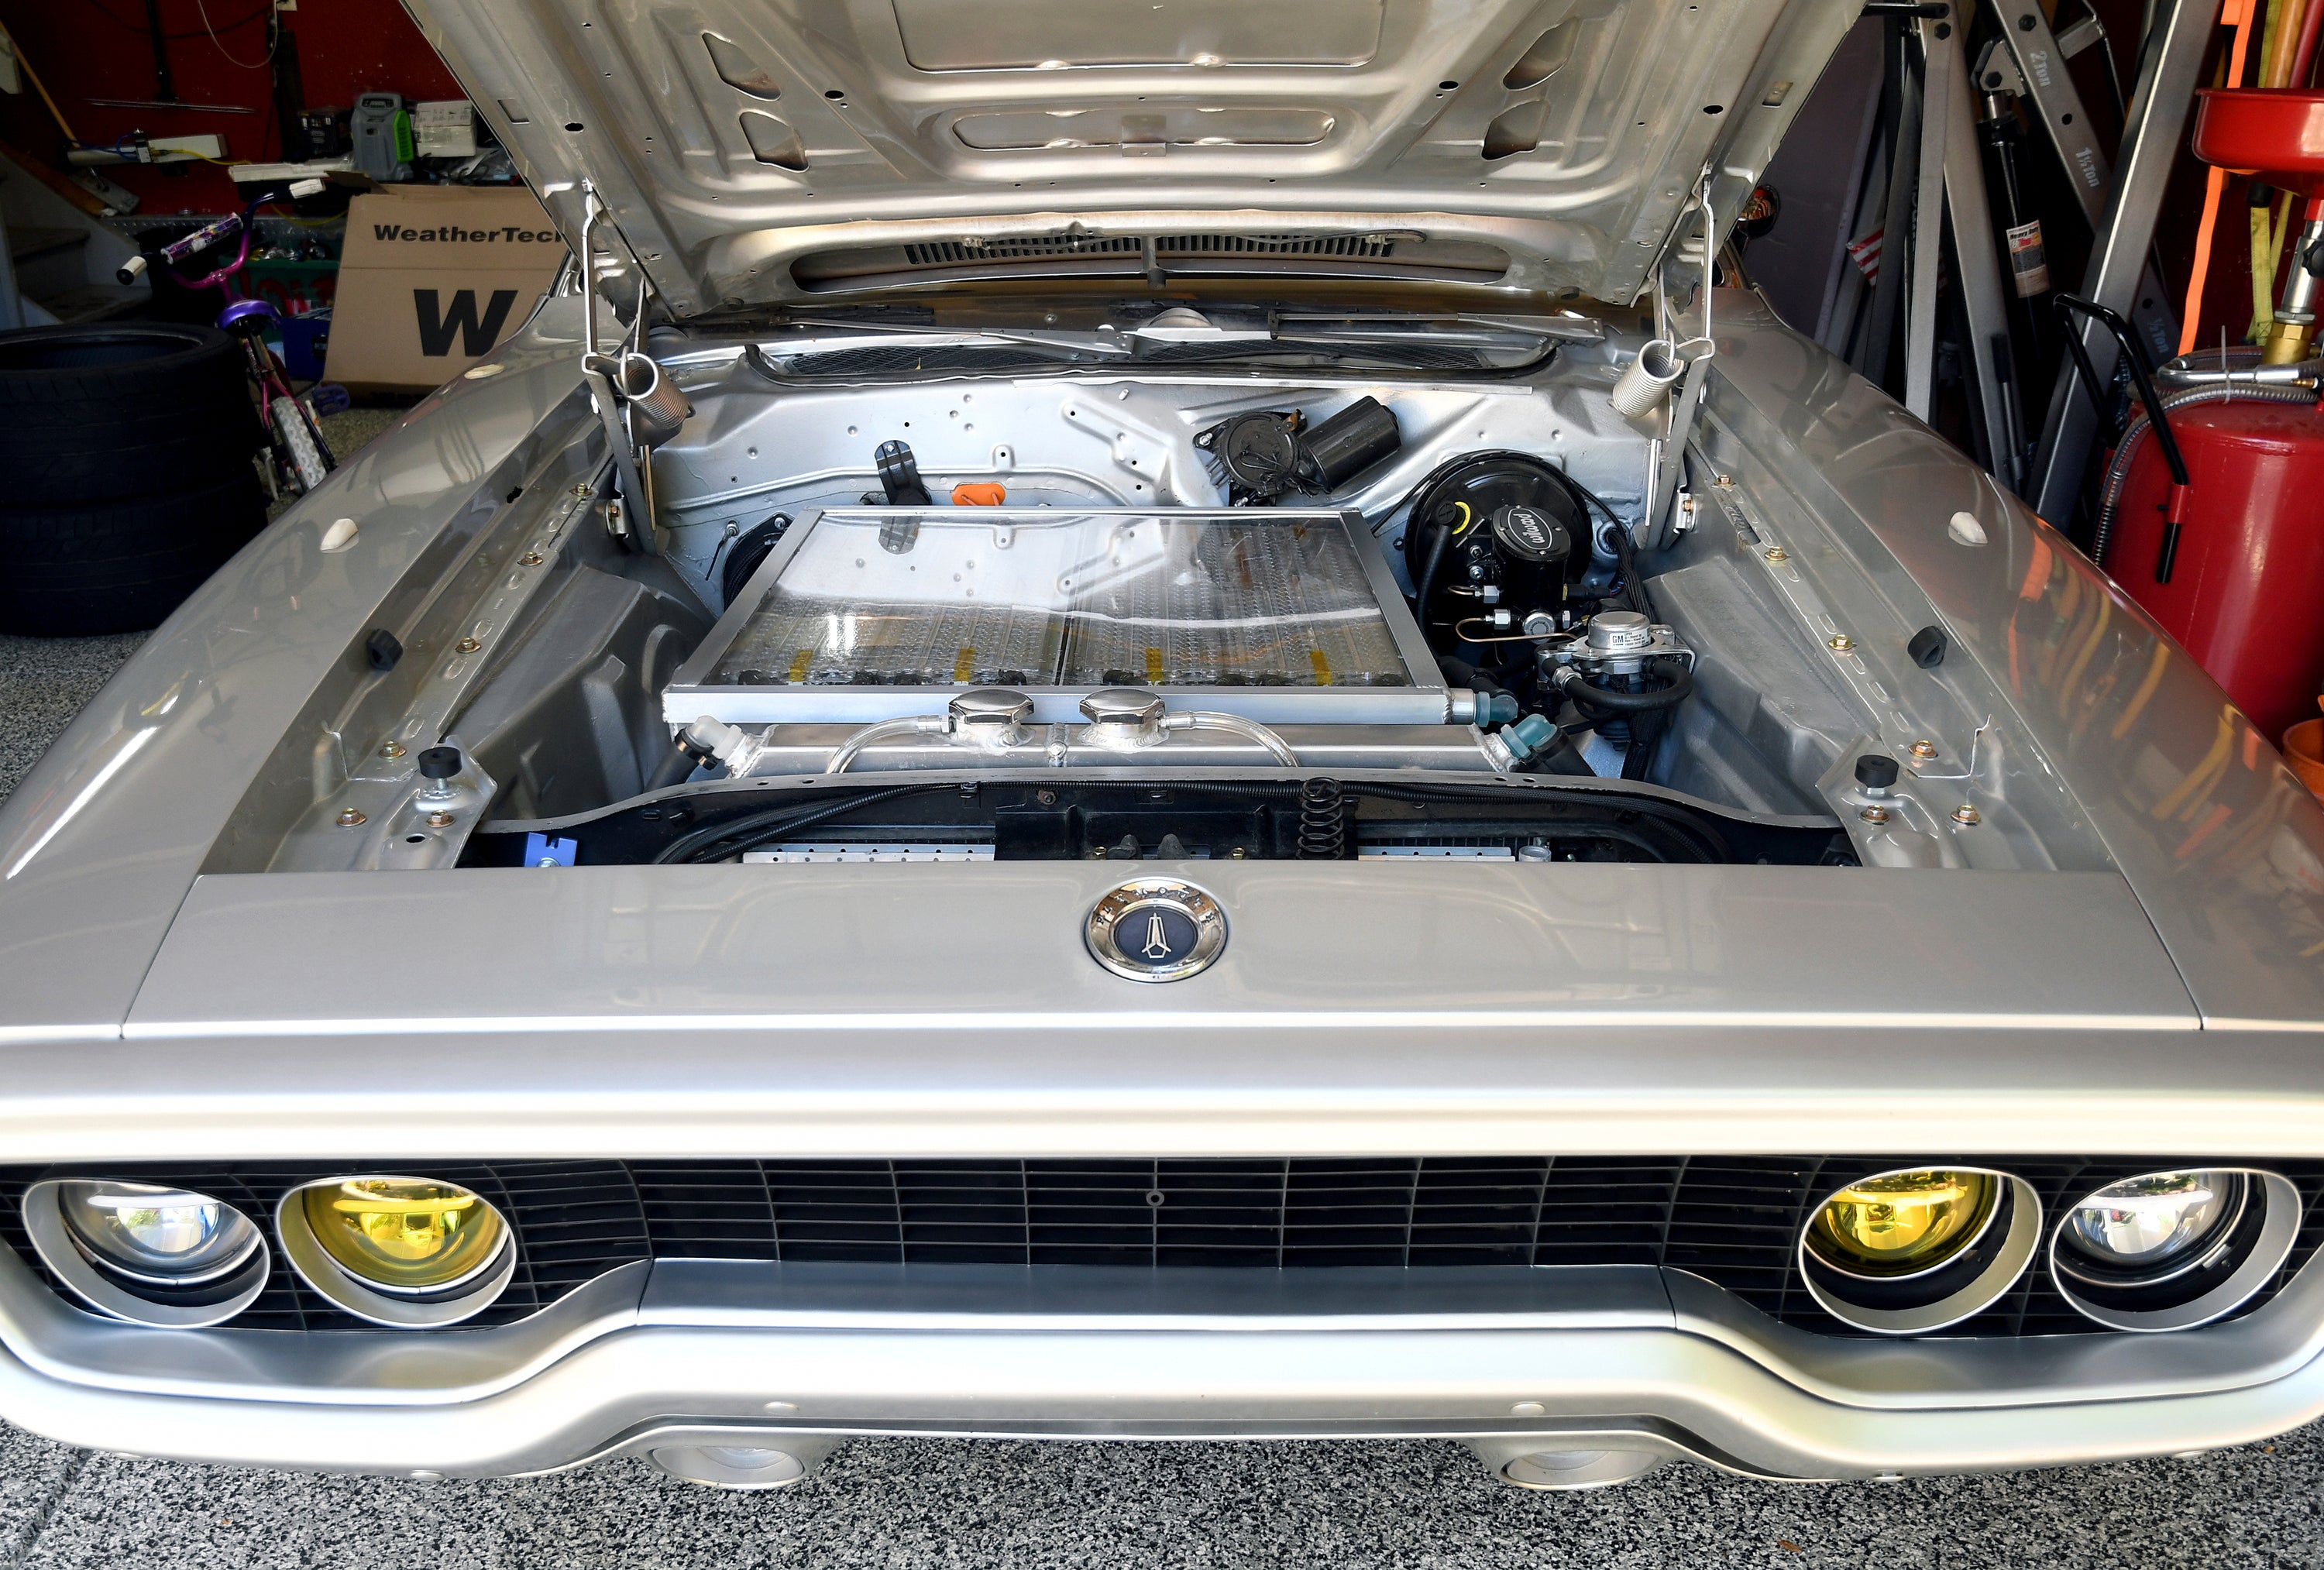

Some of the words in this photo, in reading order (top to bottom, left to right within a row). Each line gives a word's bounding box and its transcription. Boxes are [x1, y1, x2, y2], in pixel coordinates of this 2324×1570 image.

[414, 289, 518, 357] W
[1513, 514, 1545, 543] wilwood
[1612, 635, 1624, 644] GM
[1096, 886, 1215, 925] PLYMOUTH
